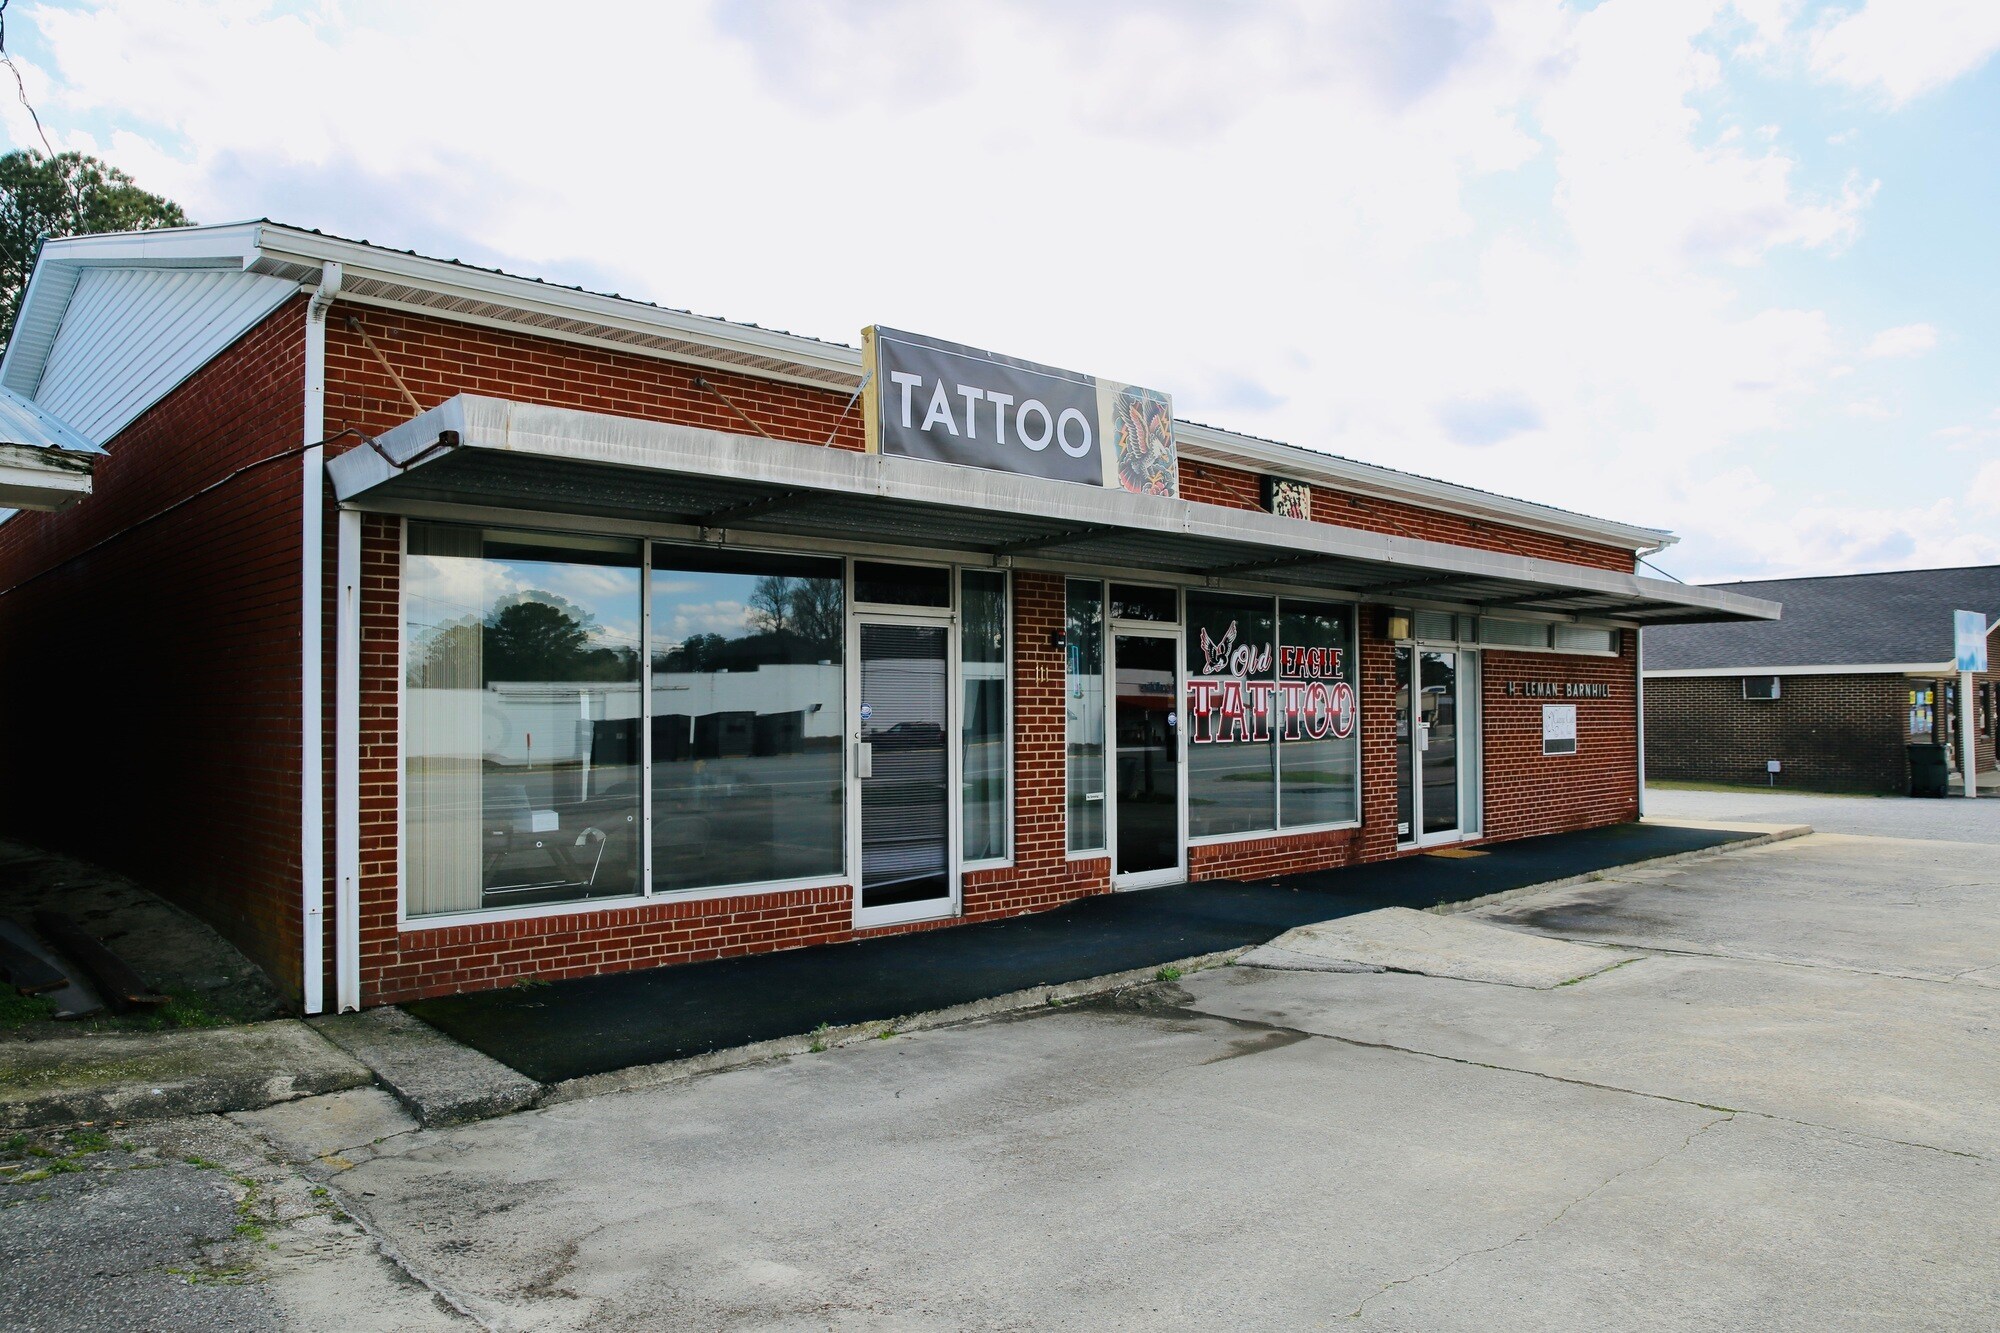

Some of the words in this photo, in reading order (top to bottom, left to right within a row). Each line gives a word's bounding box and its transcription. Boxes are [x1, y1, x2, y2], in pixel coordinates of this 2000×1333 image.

[890, 370, 1093, 459] TATTOO
[1230, 642, 1274, 678] Old
[1280, 646, 1344, 679] EAGLE
[1187, 679, 1356, 743] TATTOO
[1525, 682, 1558, 696] LEMAN
[1566, 683, 1611, 698] BARNHILL
